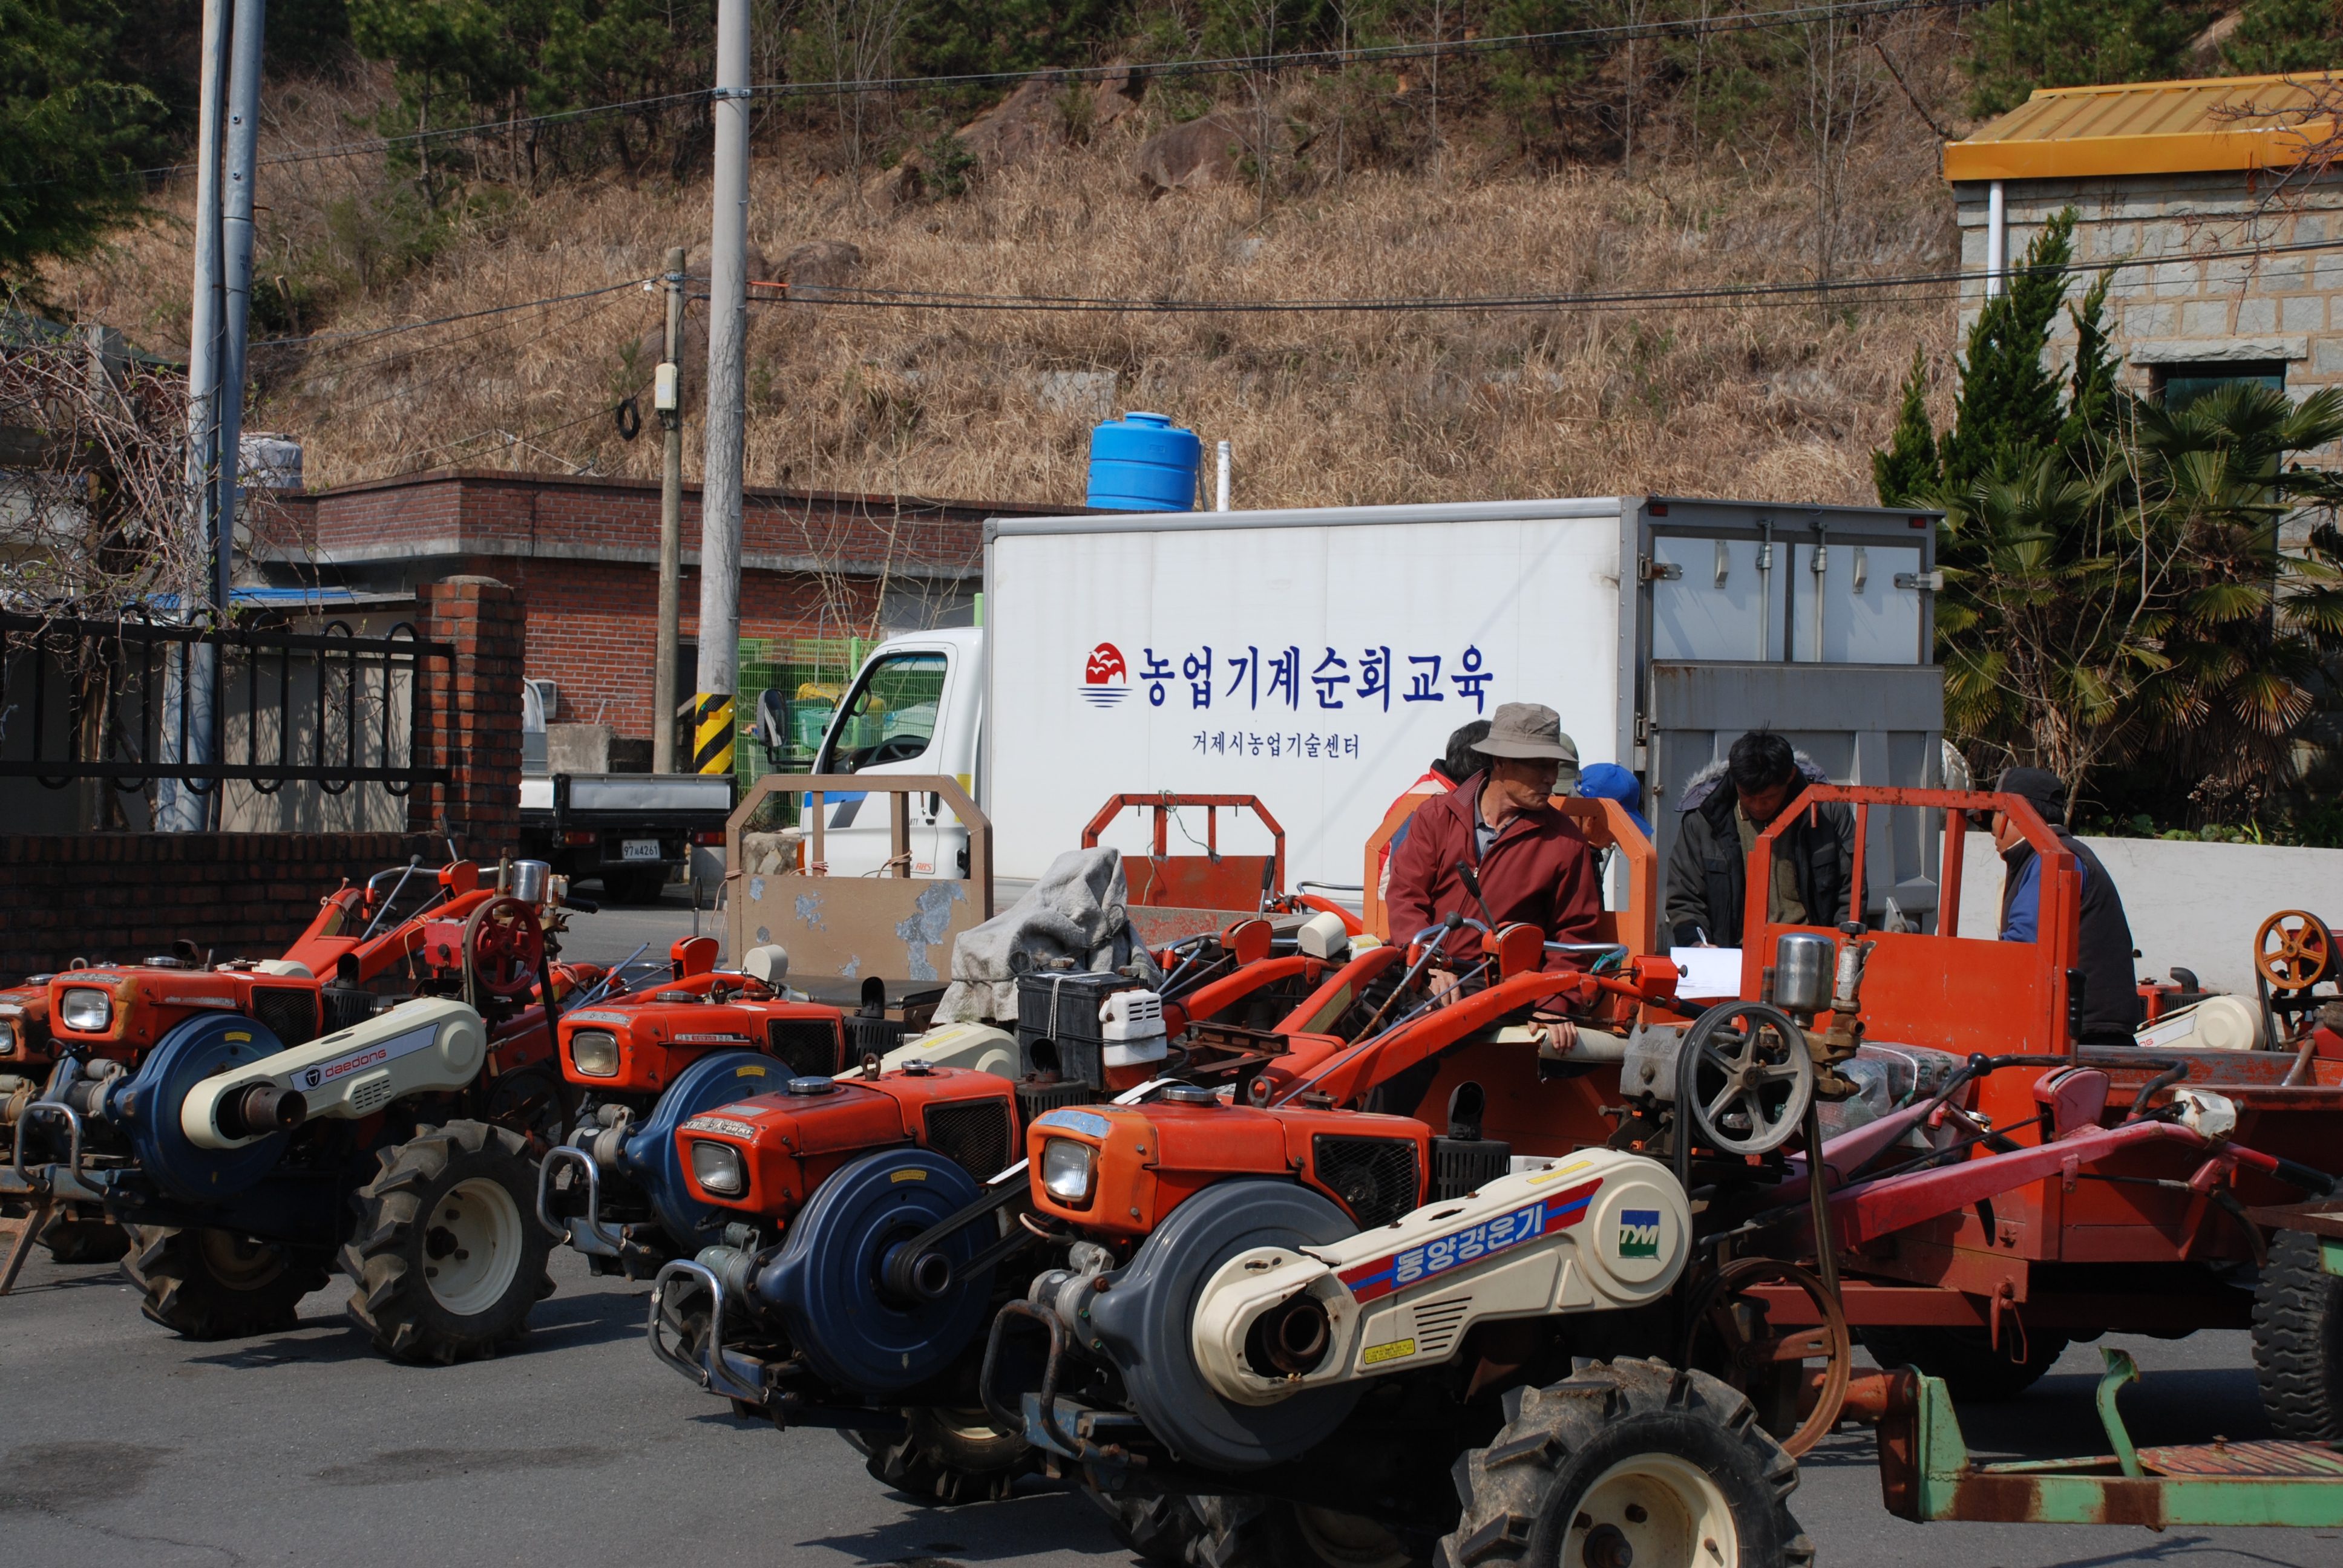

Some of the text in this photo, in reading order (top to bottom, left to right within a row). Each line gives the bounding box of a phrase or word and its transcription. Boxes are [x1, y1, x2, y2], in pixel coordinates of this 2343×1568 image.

[1192, 730, 1358, 760] 거제시농업기술센터
[915, 862, 933, 871] ABS
[1396, 1204, 1543, 1282] 동양경운기
[1620, 1224, 1659, 1245] TYM
